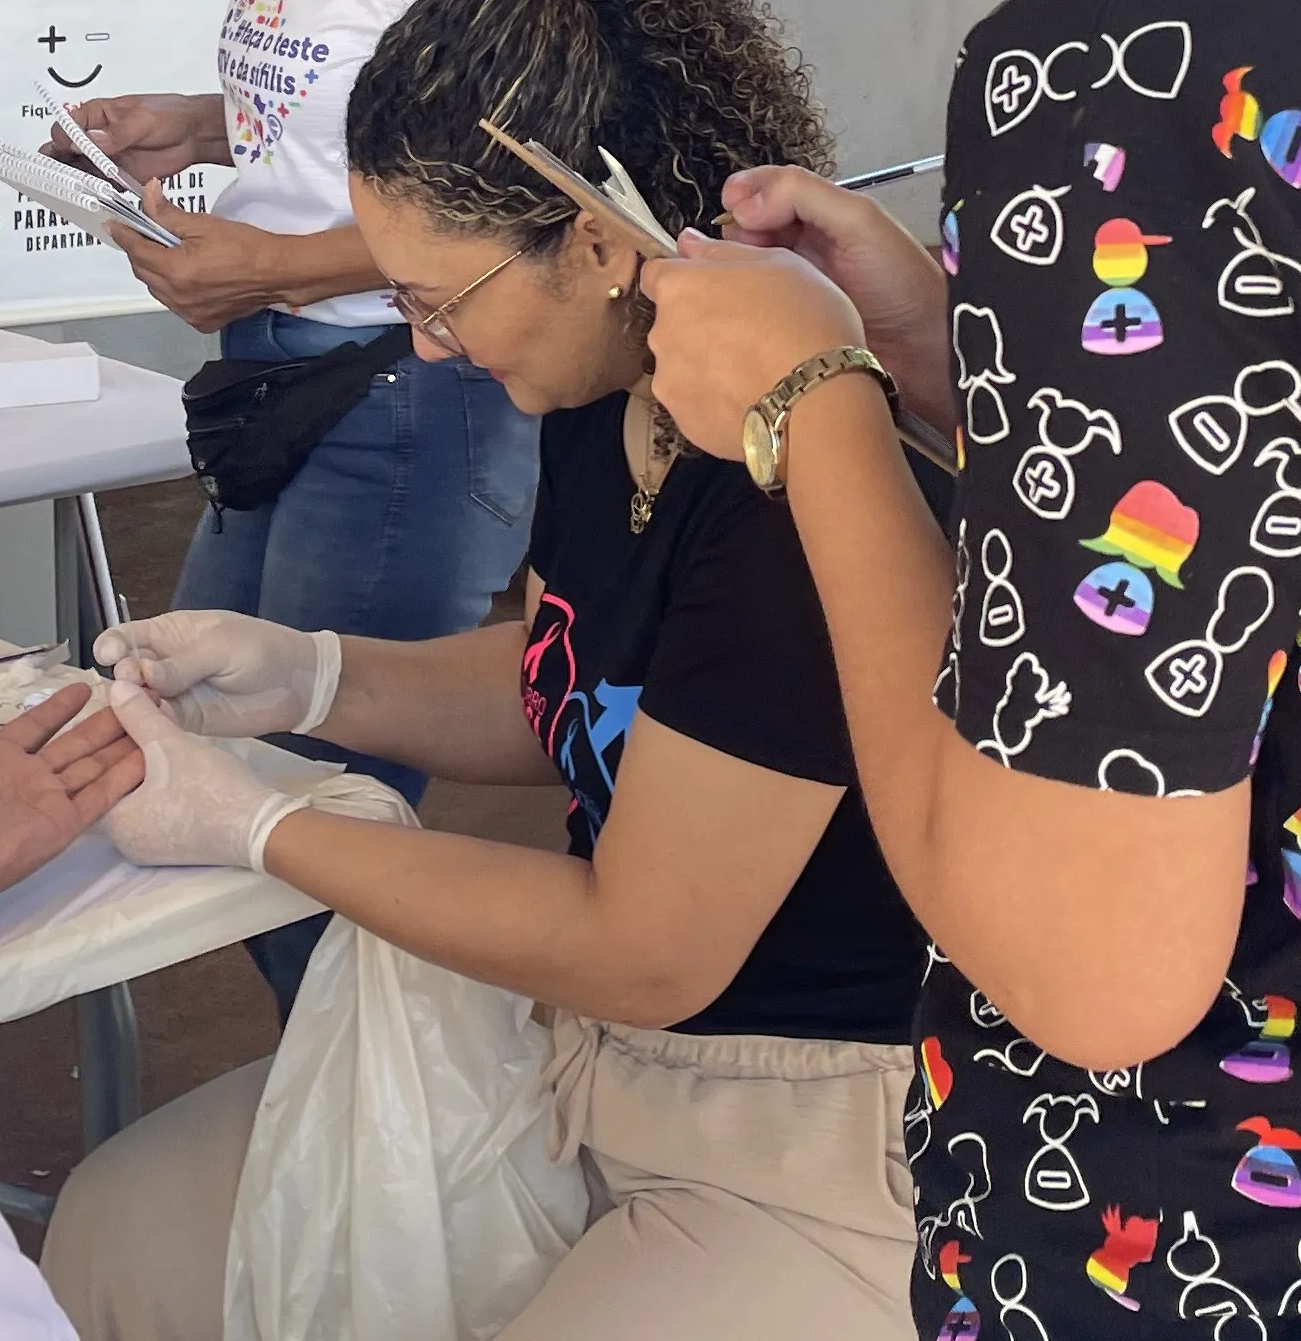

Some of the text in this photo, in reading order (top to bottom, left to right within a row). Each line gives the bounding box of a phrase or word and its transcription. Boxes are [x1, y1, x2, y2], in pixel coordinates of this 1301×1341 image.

[273, 32, 330, 63] teste
[249, 61, 296, 95] sífilis
[189, 172, 204, 188] DE
